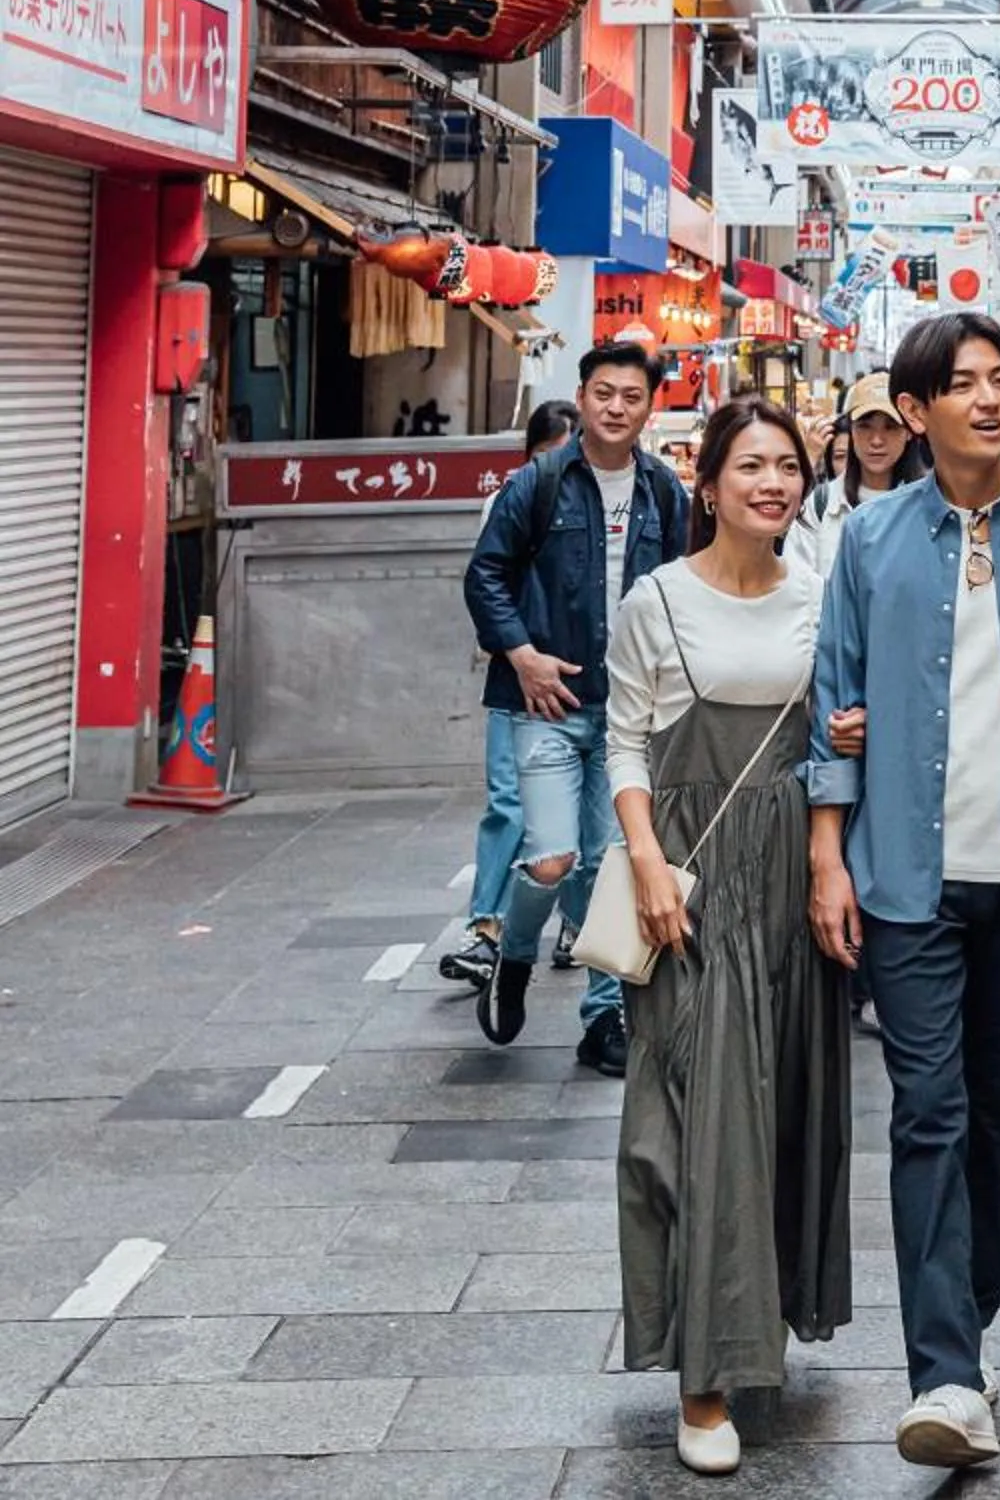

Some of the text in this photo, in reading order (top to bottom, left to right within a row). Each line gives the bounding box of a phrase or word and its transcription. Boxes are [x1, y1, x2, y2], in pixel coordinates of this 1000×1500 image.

[889, 76, 982, 113] 200
[335, 457, 437, 498] てっちり
